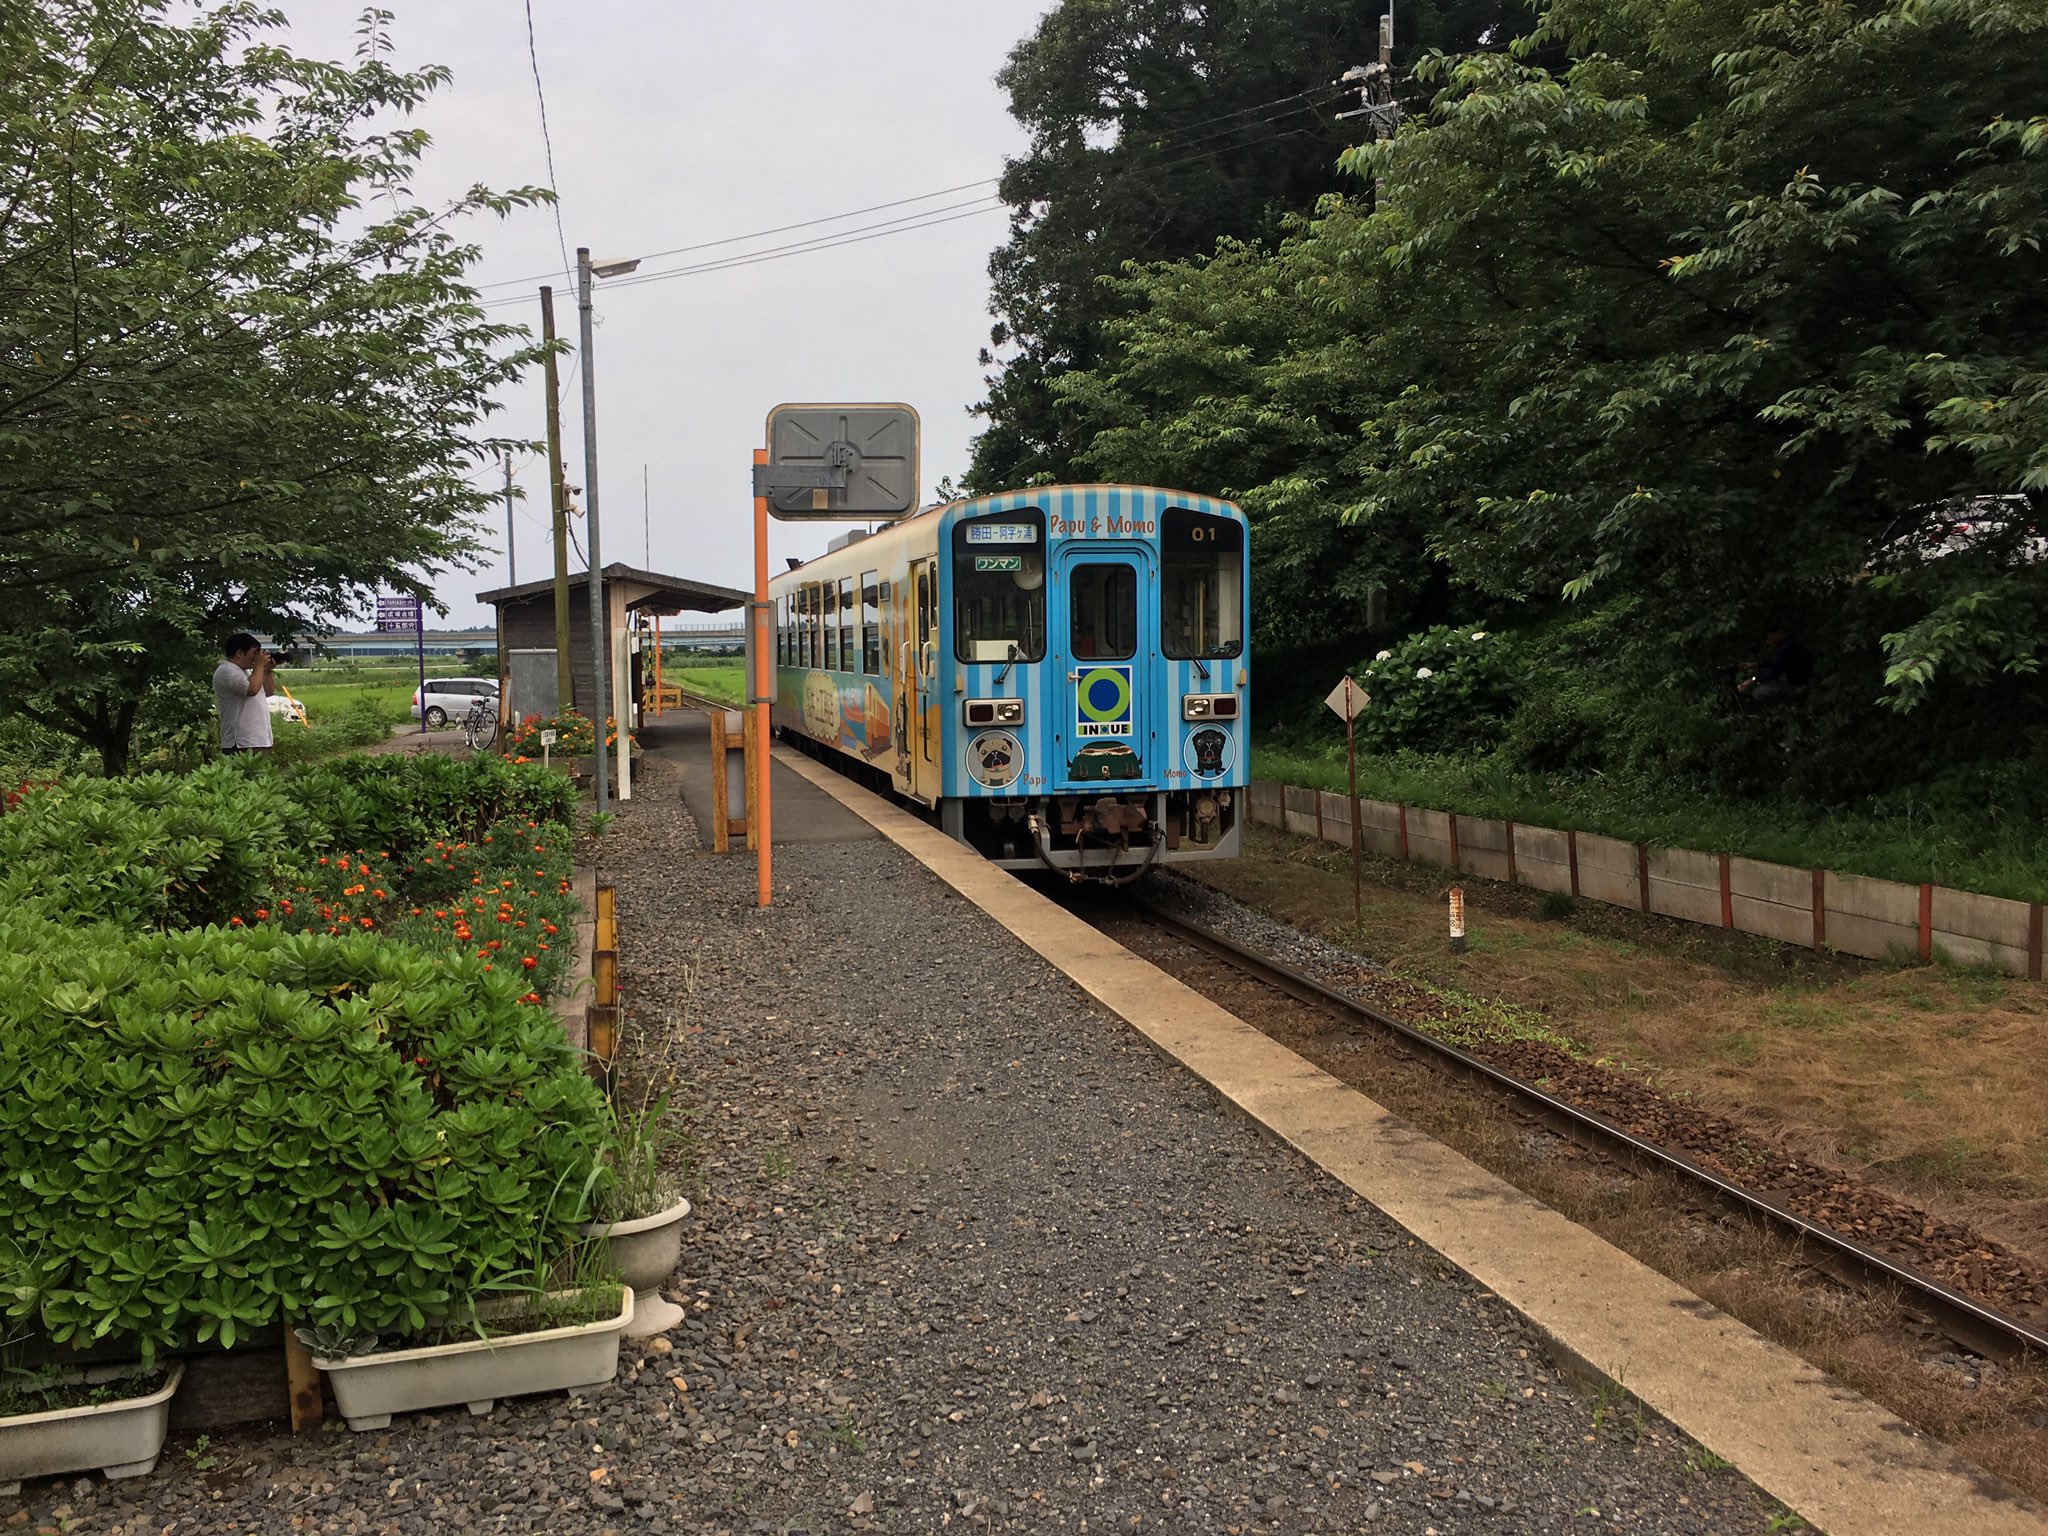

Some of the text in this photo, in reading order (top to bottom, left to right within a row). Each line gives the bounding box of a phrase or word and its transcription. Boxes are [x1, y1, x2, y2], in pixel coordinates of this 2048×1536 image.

[1050, 514, 1155, 536] Papu & Momo
[977, 558, 1019, 569] ワンマン
[1083, 724, 1128, 735] INOUE
[1163, 768, 1187, 779] Momo
[1023, 773, 1047, 787] Papu
